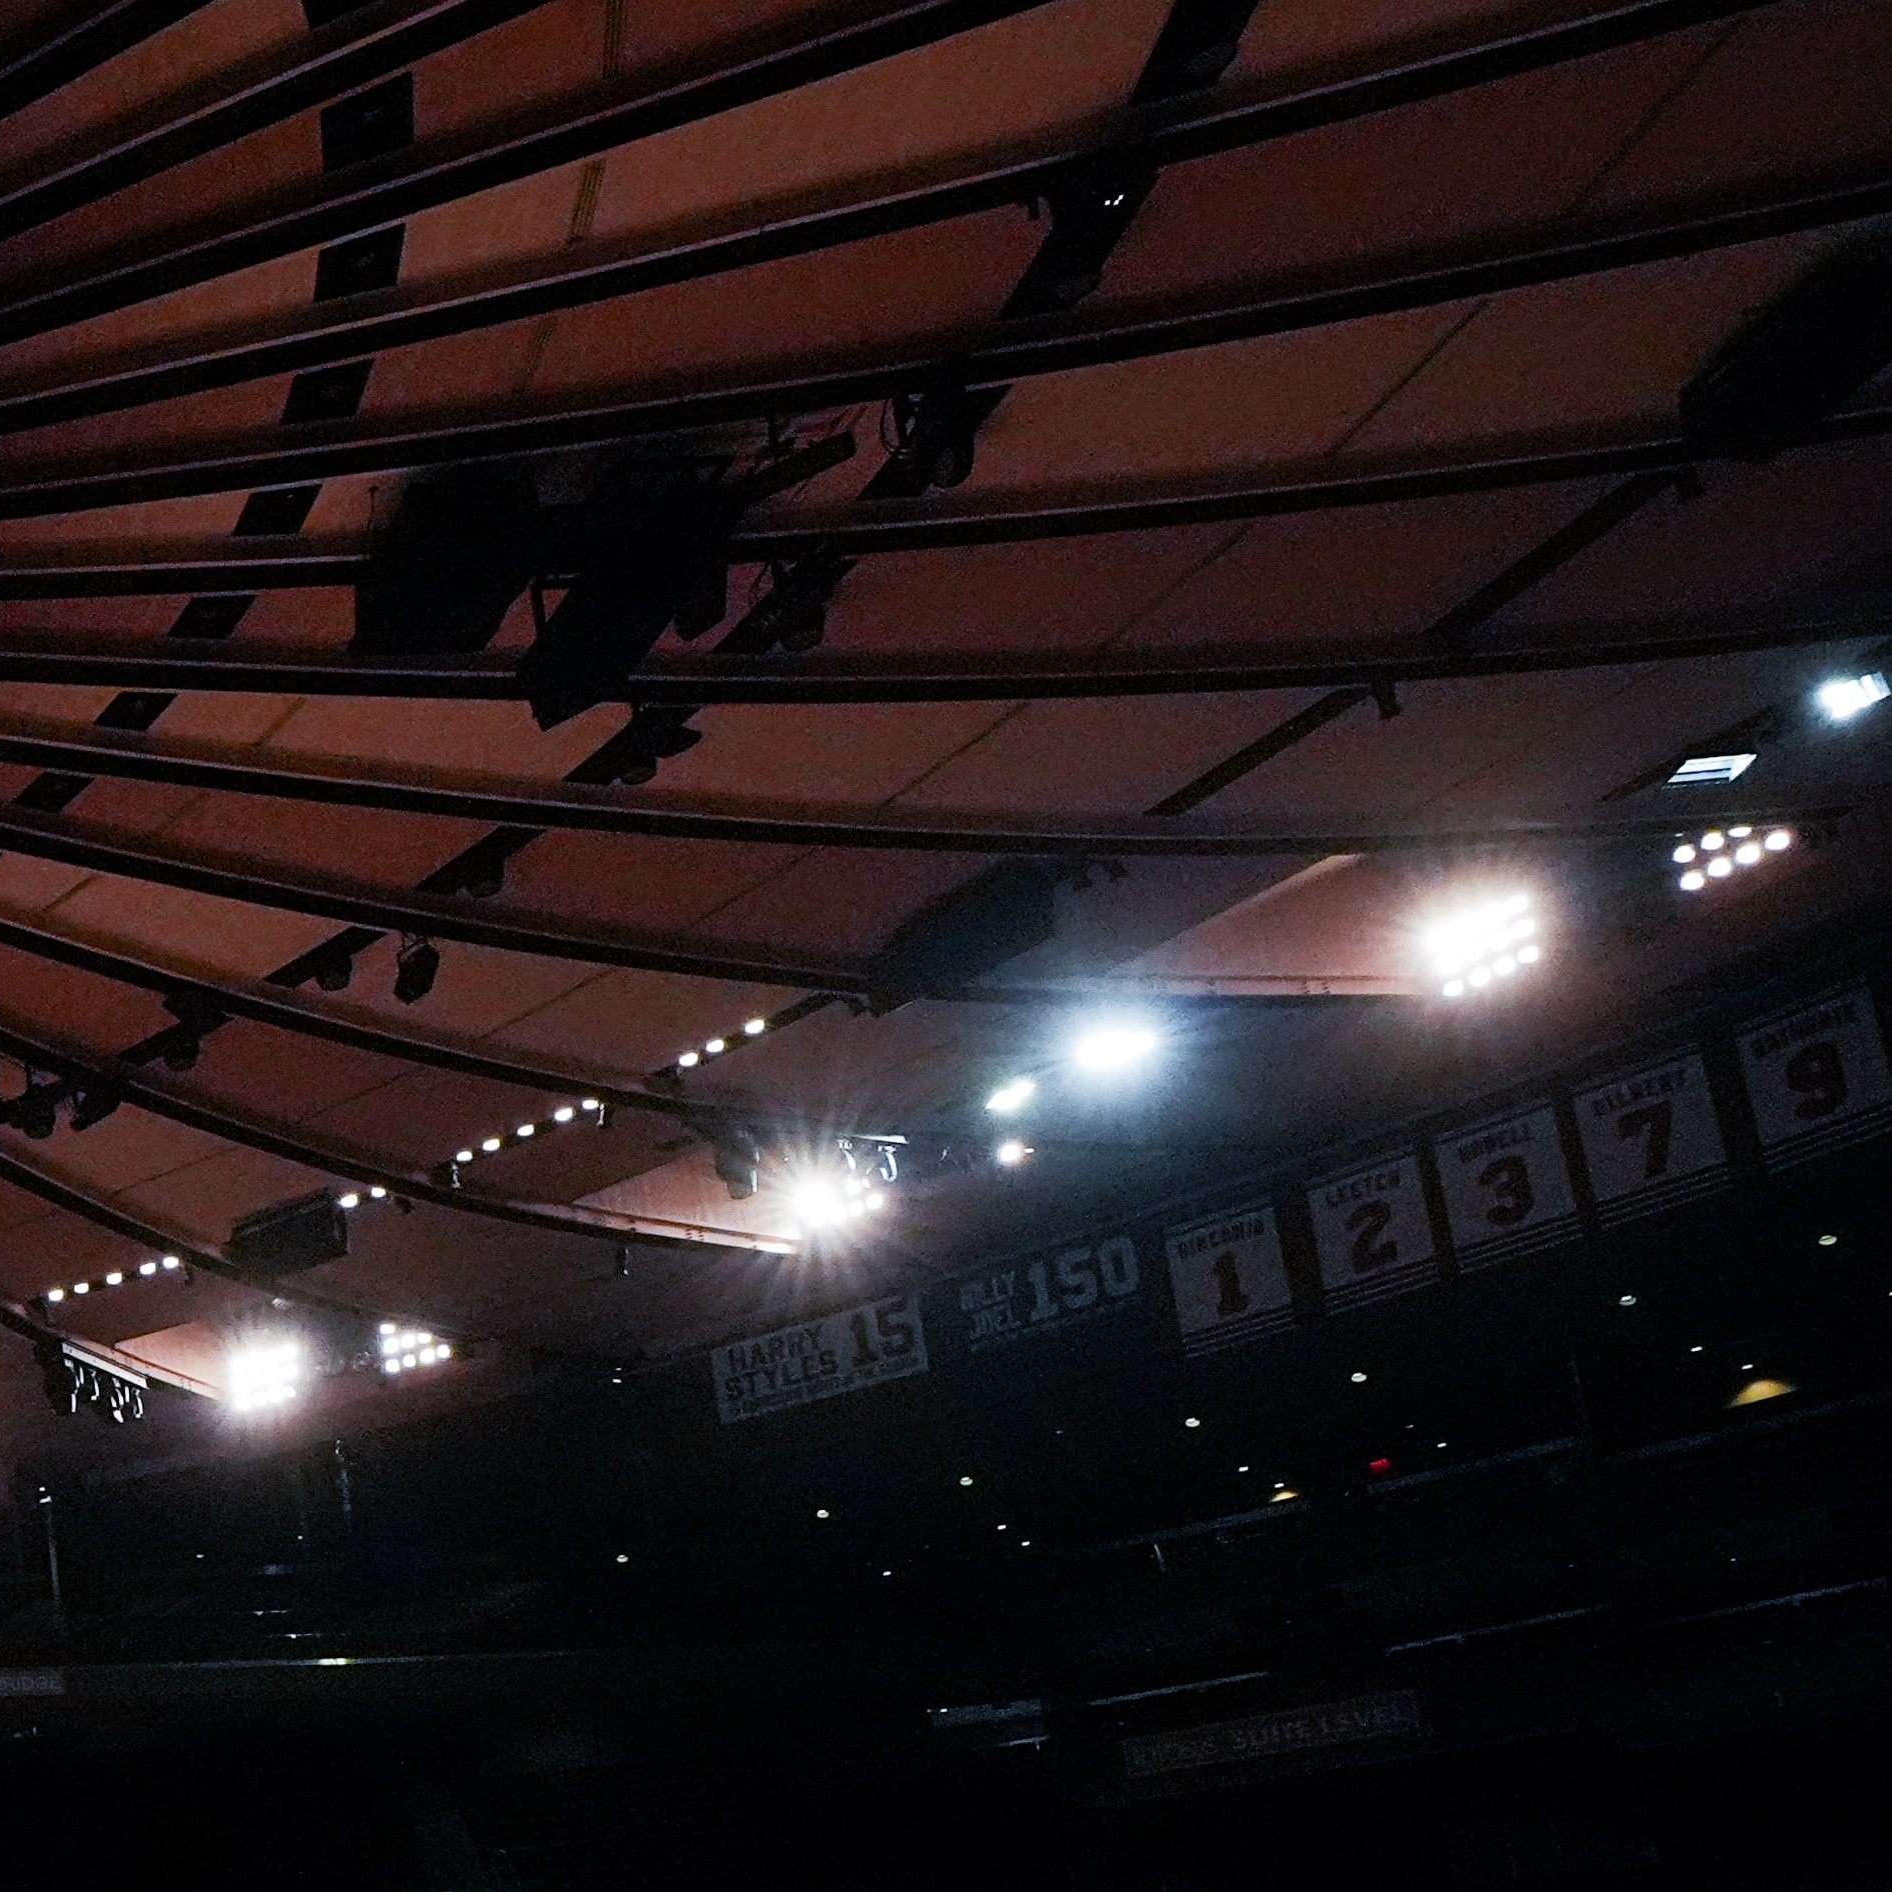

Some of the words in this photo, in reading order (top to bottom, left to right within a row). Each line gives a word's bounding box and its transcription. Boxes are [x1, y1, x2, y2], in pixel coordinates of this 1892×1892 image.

[1784, 1041, 1850, 1122] 9
[1617, 1100, 1673, 1180] 7
[1477, 1153, 1535, 1228] 3
[1345, 1198, 1398, 1275] 2
[1028, 1234, 1140, 1323] 150
[1211, 1250, 1251, 1317] 1
[728, 1325, 822, 1372] HARRY
[849, 1300, 917, 1369] 15
[725, 1348, 838, 1402] STYLES
